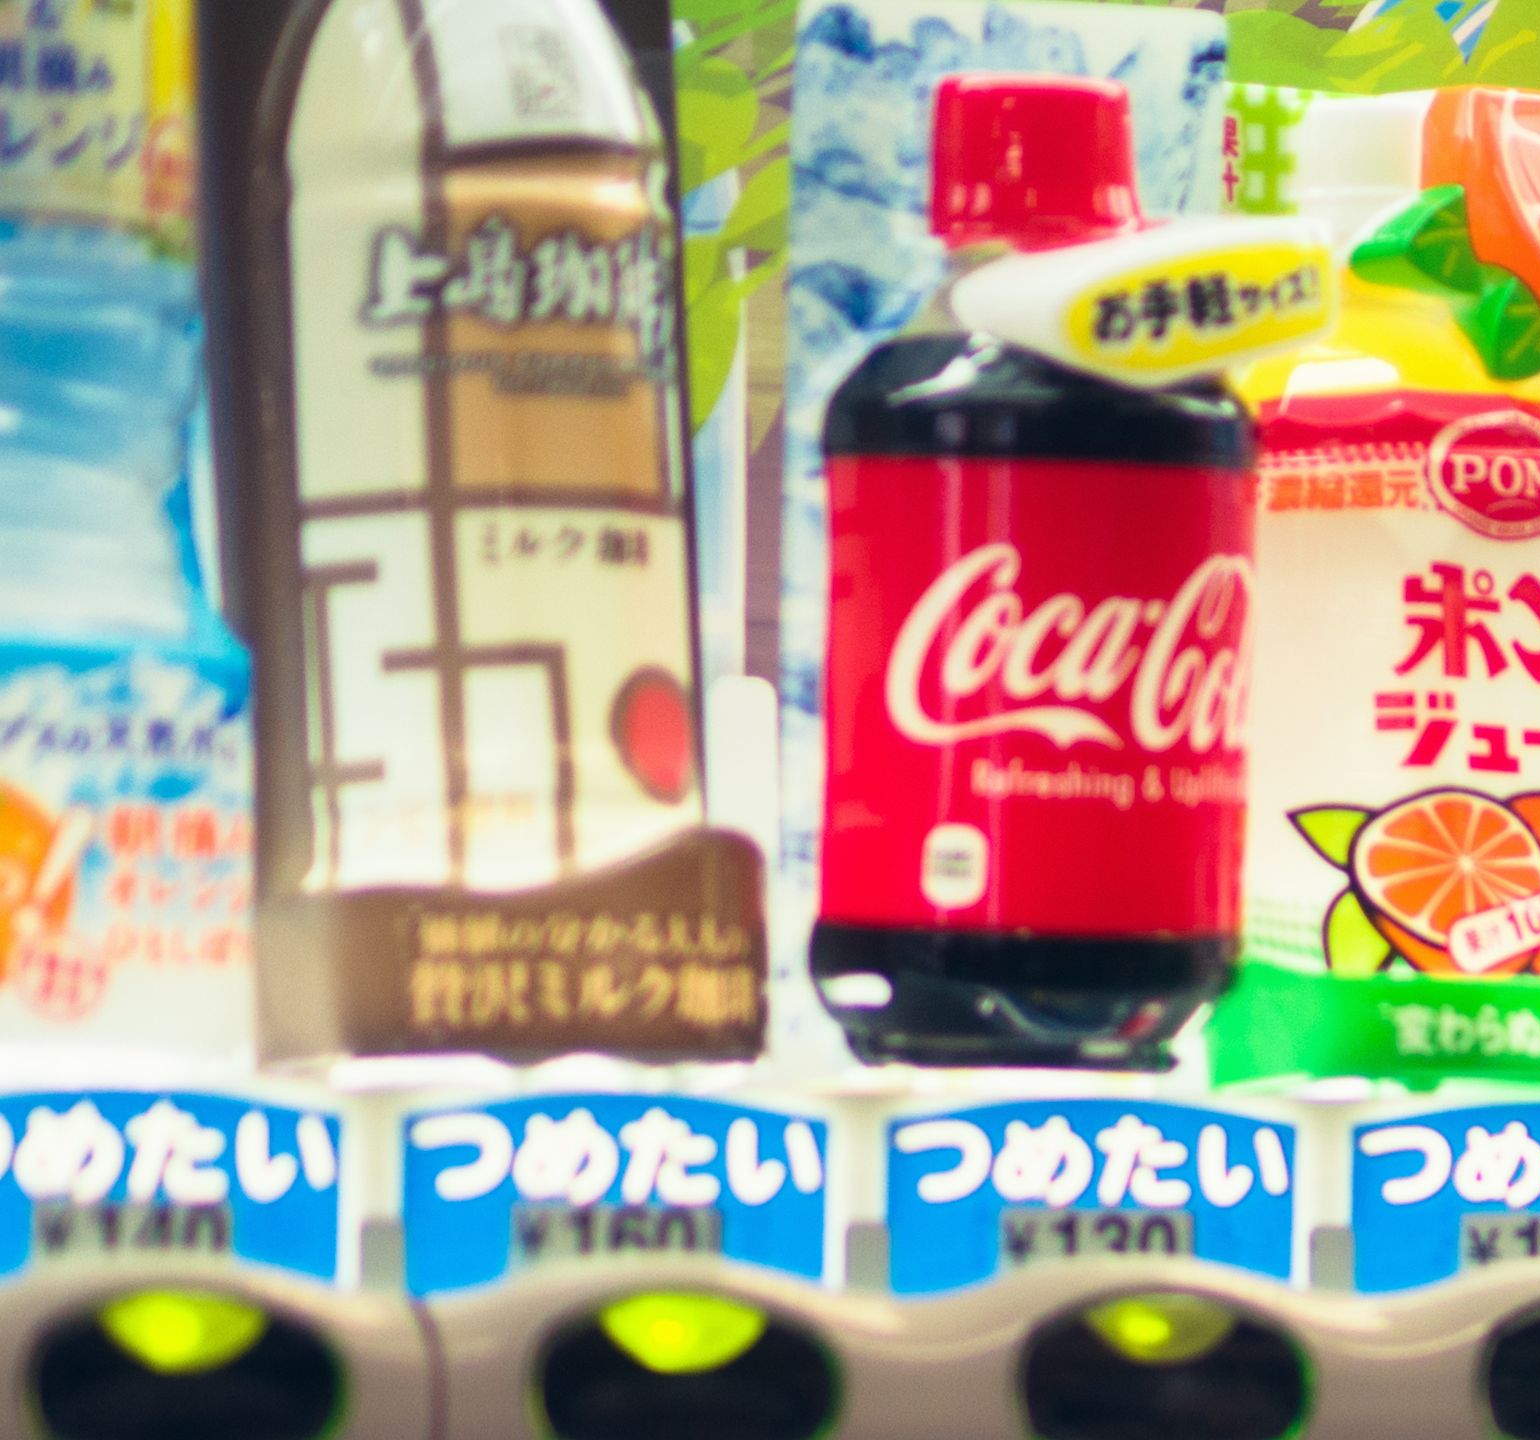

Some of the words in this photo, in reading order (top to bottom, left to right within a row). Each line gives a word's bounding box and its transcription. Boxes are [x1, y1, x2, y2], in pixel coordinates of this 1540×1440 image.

[1091, 271, 1320, 345] お手軽サイズ!
[409, 1106, 824, 1205] つめたい
[894, 1114, 1290, 1210] つめたい
